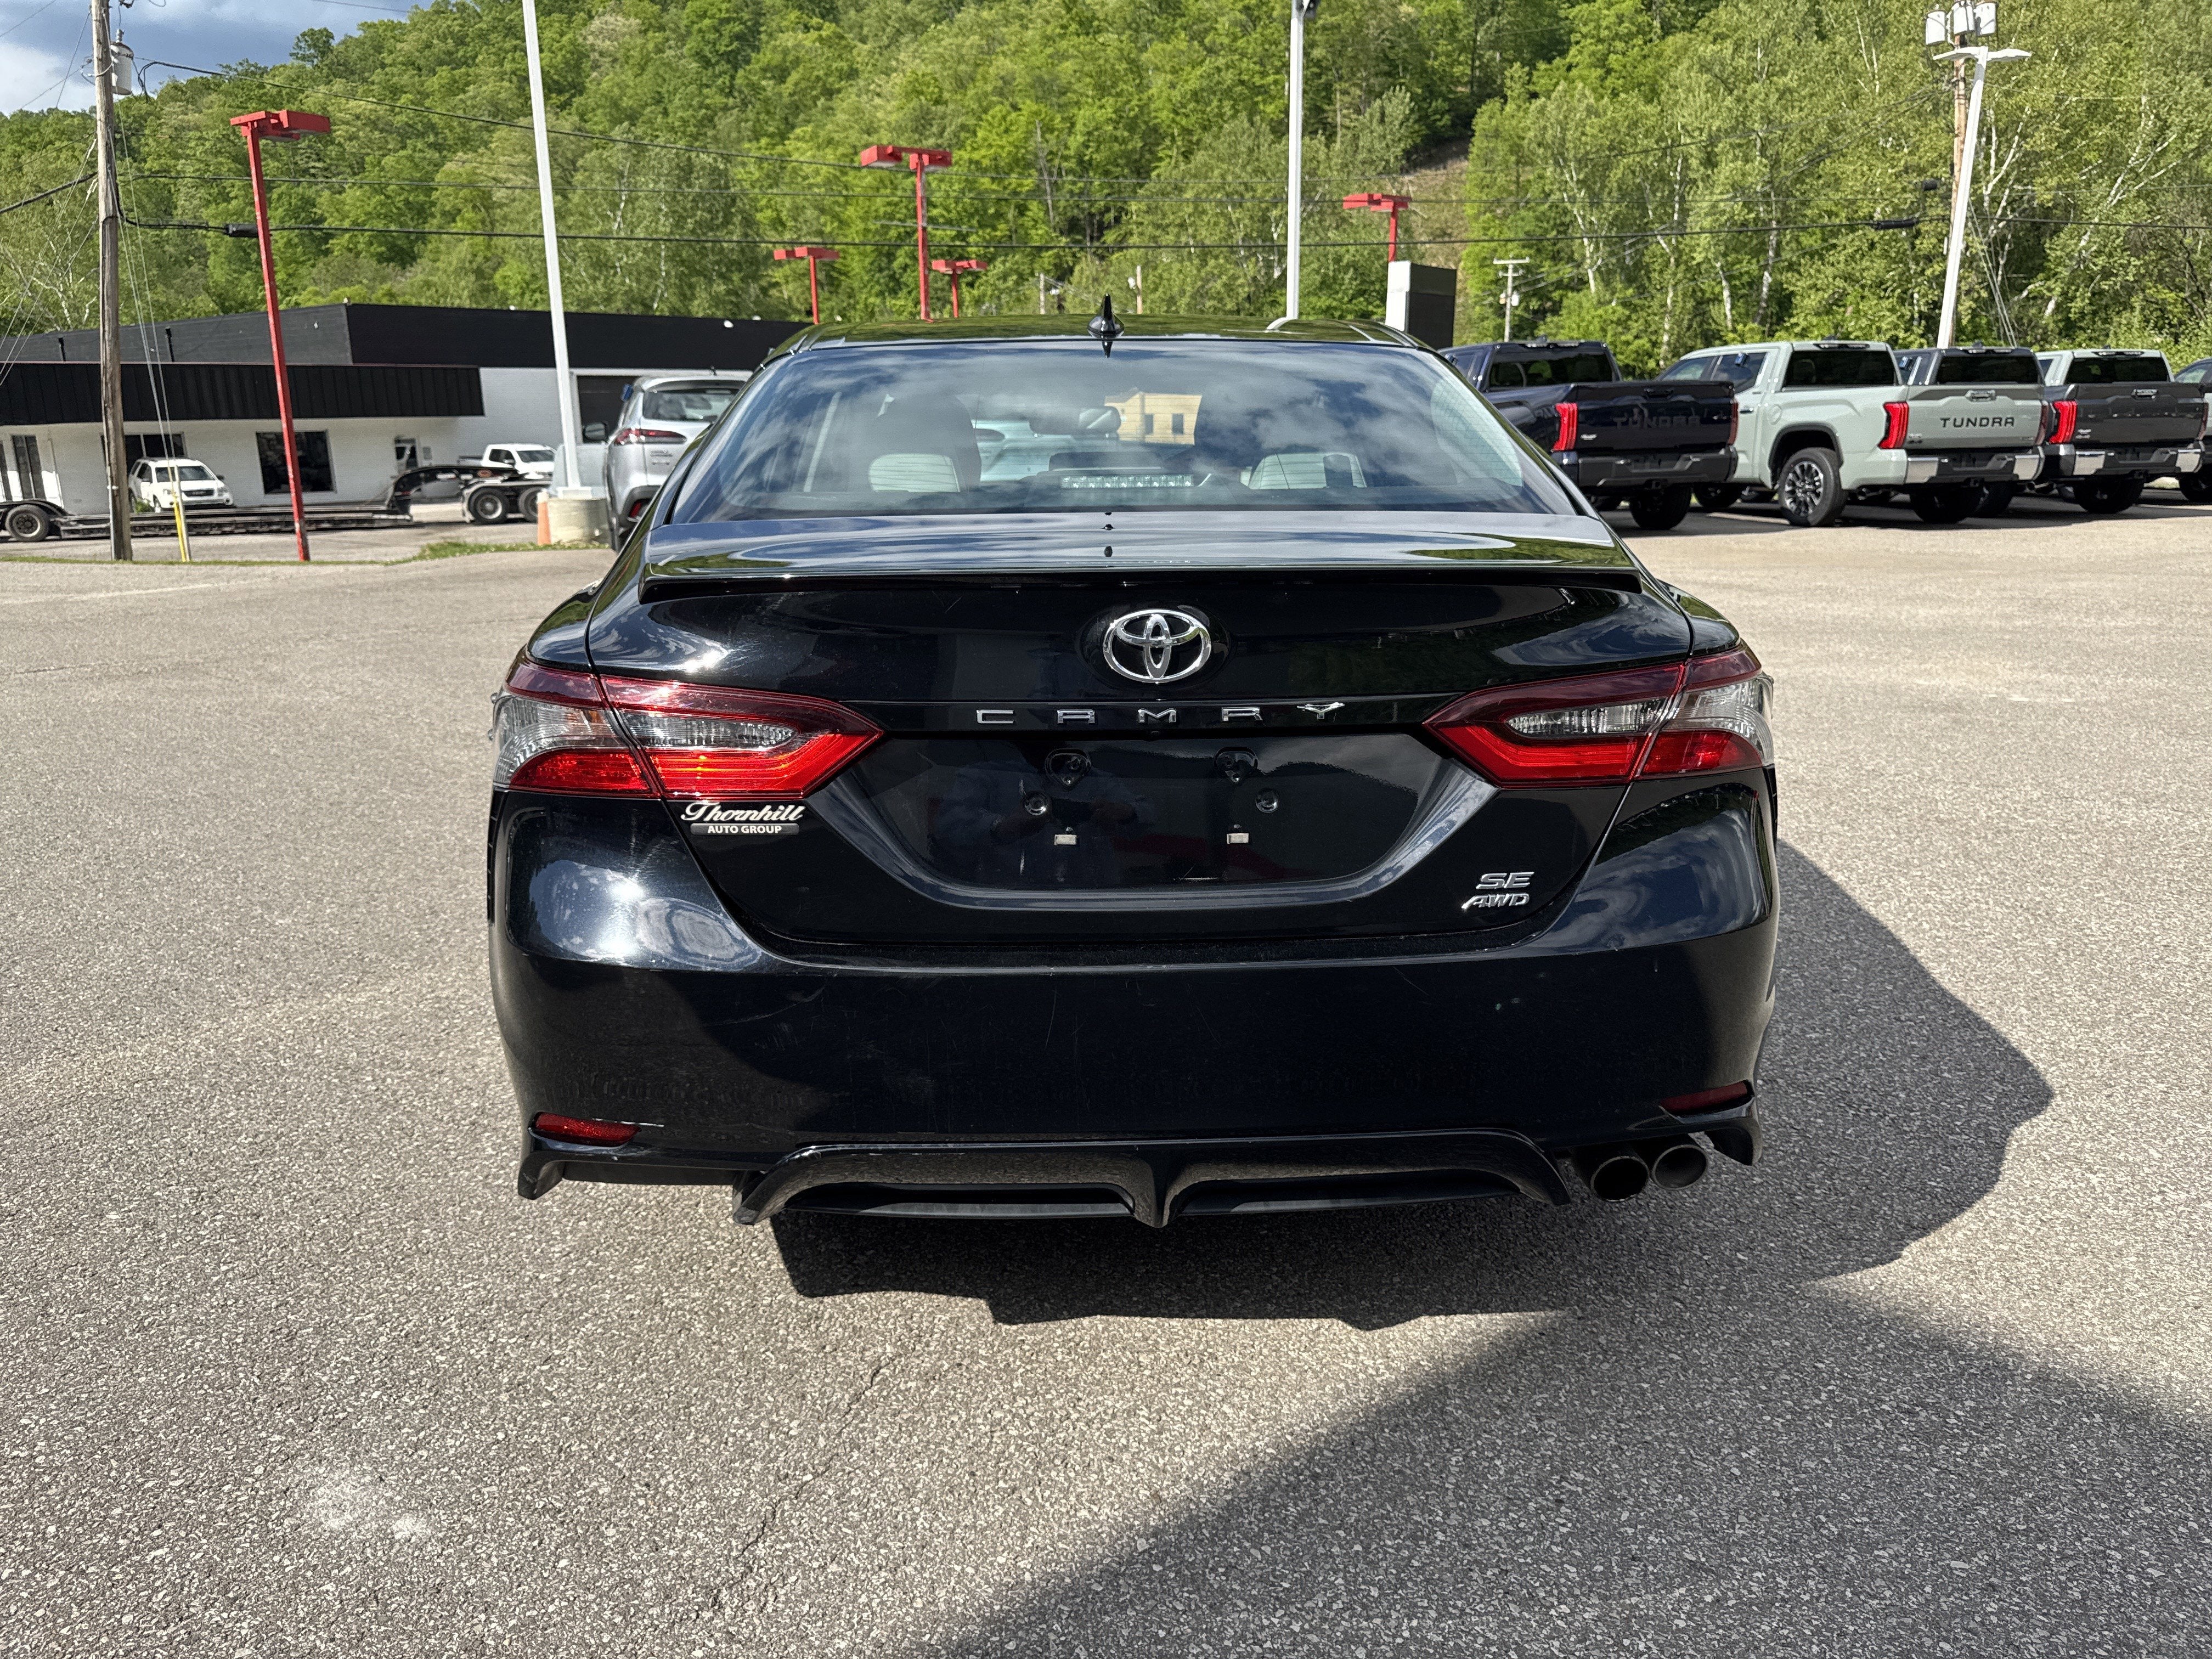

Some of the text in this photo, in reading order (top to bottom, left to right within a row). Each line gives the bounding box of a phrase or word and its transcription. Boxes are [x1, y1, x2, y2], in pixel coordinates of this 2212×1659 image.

[1940, 416, 2015, 428] TUNDRA
[976, 701, 1345, 724] CAMRY
[680, 801, 805, 822] Thornhill
[707, 825, 782, 834] AUTO GROUP
[1476, 871, 1534, 889] SE
[1461, 893, 1530, 910] AWD
